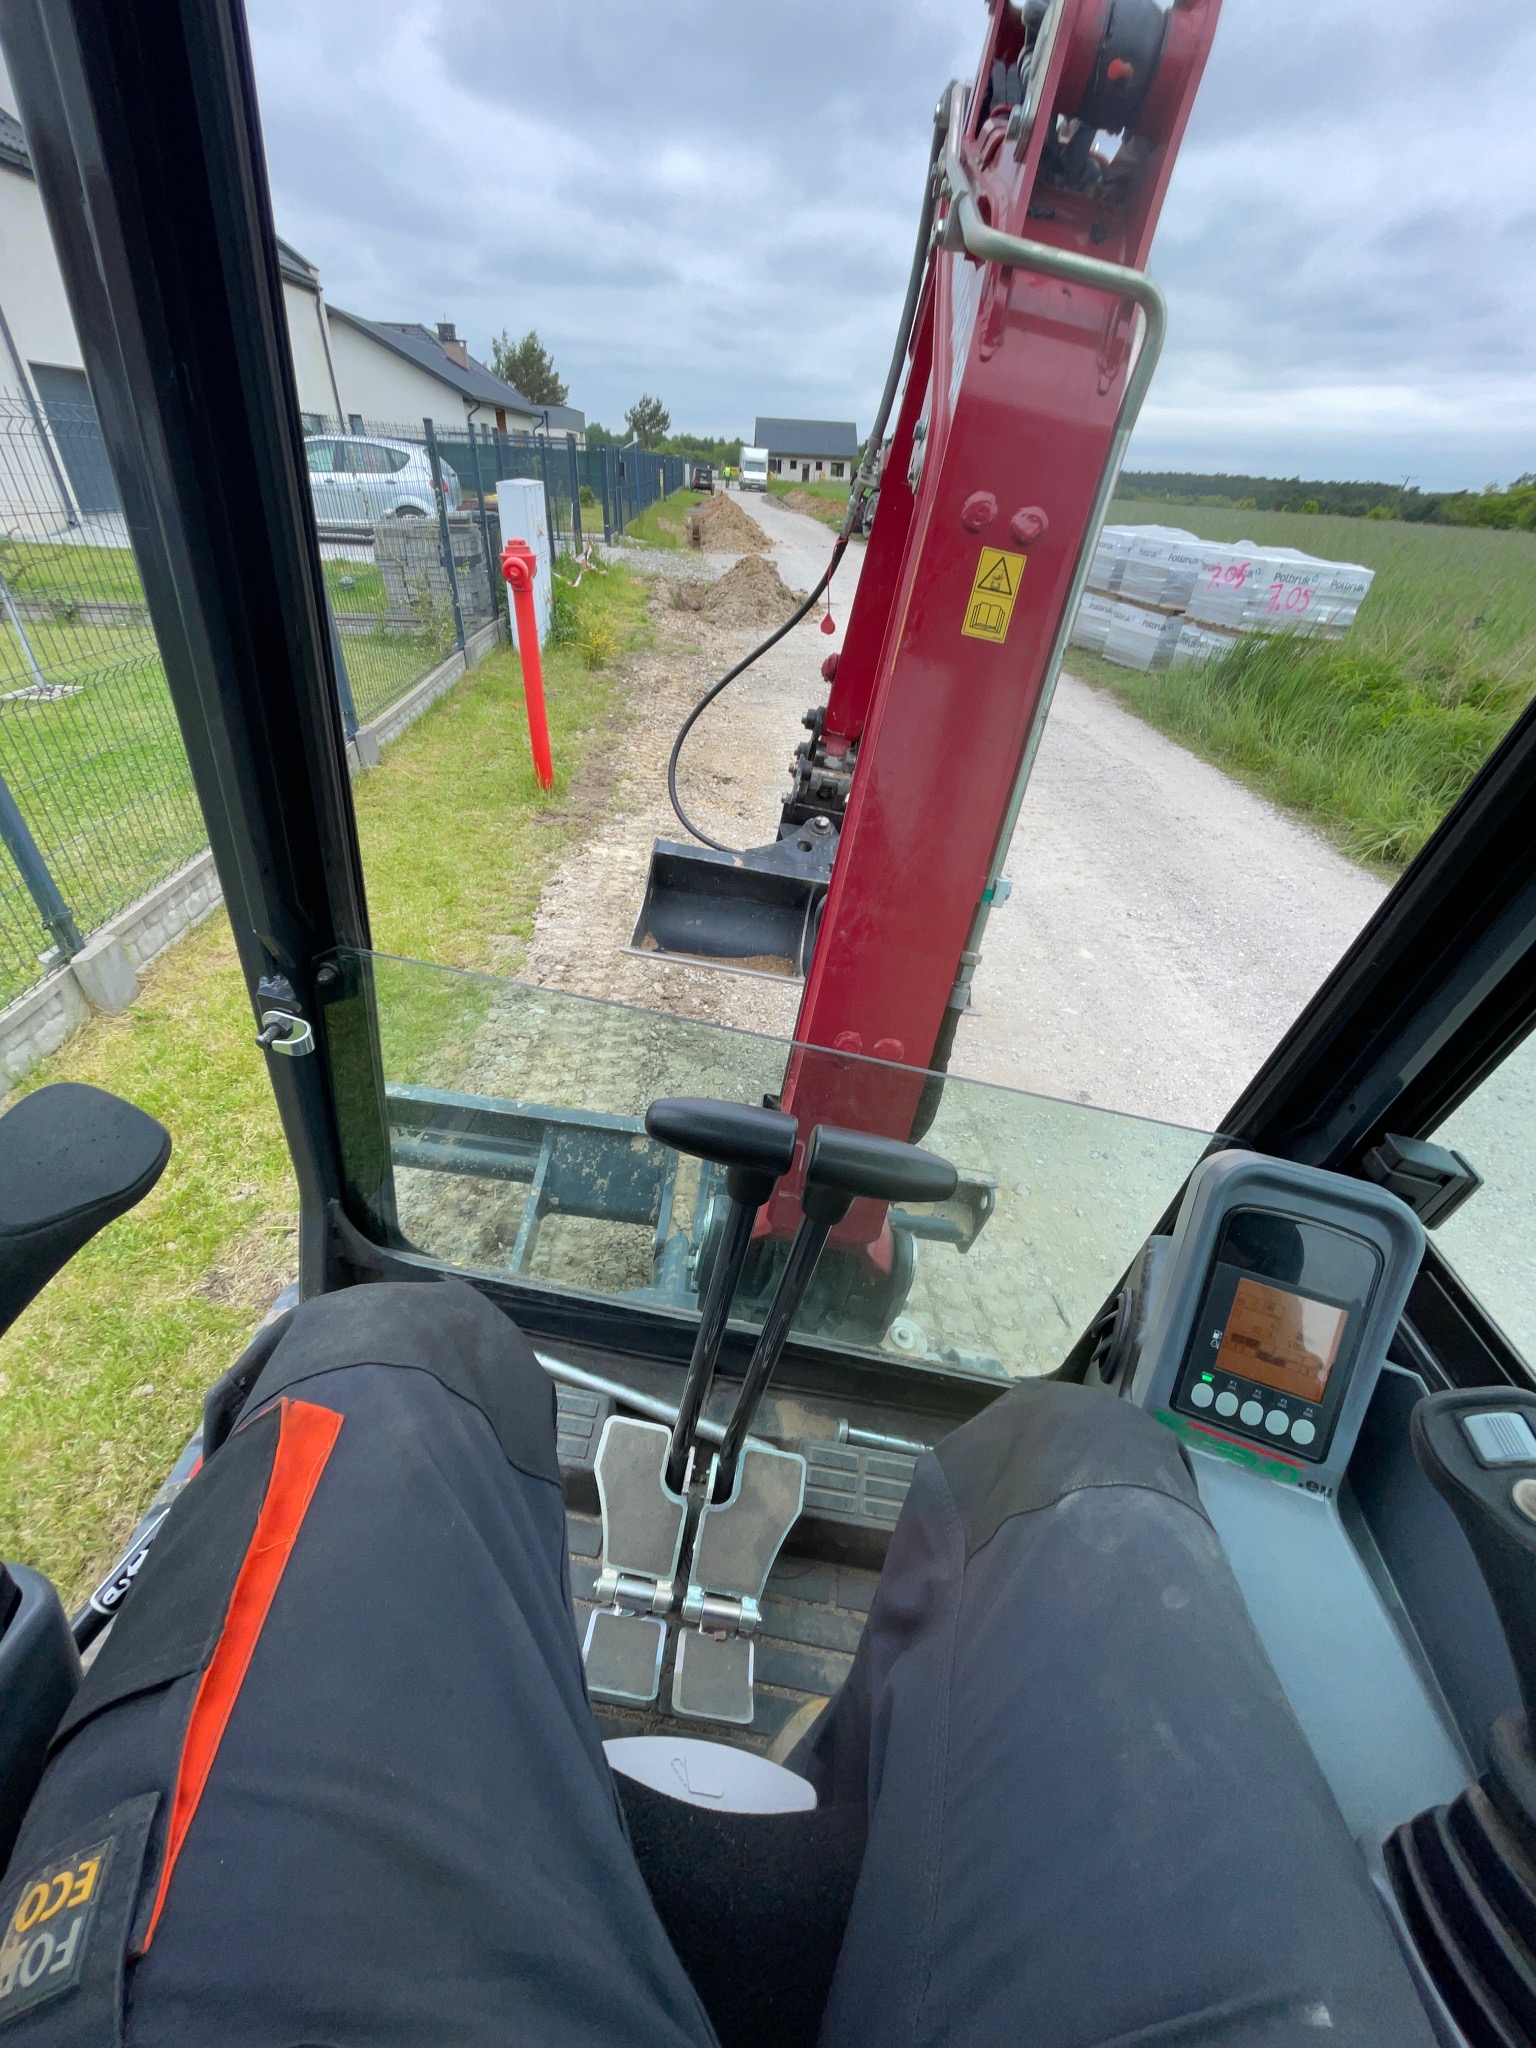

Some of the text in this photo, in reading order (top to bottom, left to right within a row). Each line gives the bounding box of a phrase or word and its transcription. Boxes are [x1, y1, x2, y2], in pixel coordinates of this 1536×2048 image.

[1273, 572, 1311, 586] Polbruk
[1330, 579, 1365, 592] Polbruk
[1142, 620, 1168, 632] Polbruk
[15, 1855, 101, 1933] ECO
